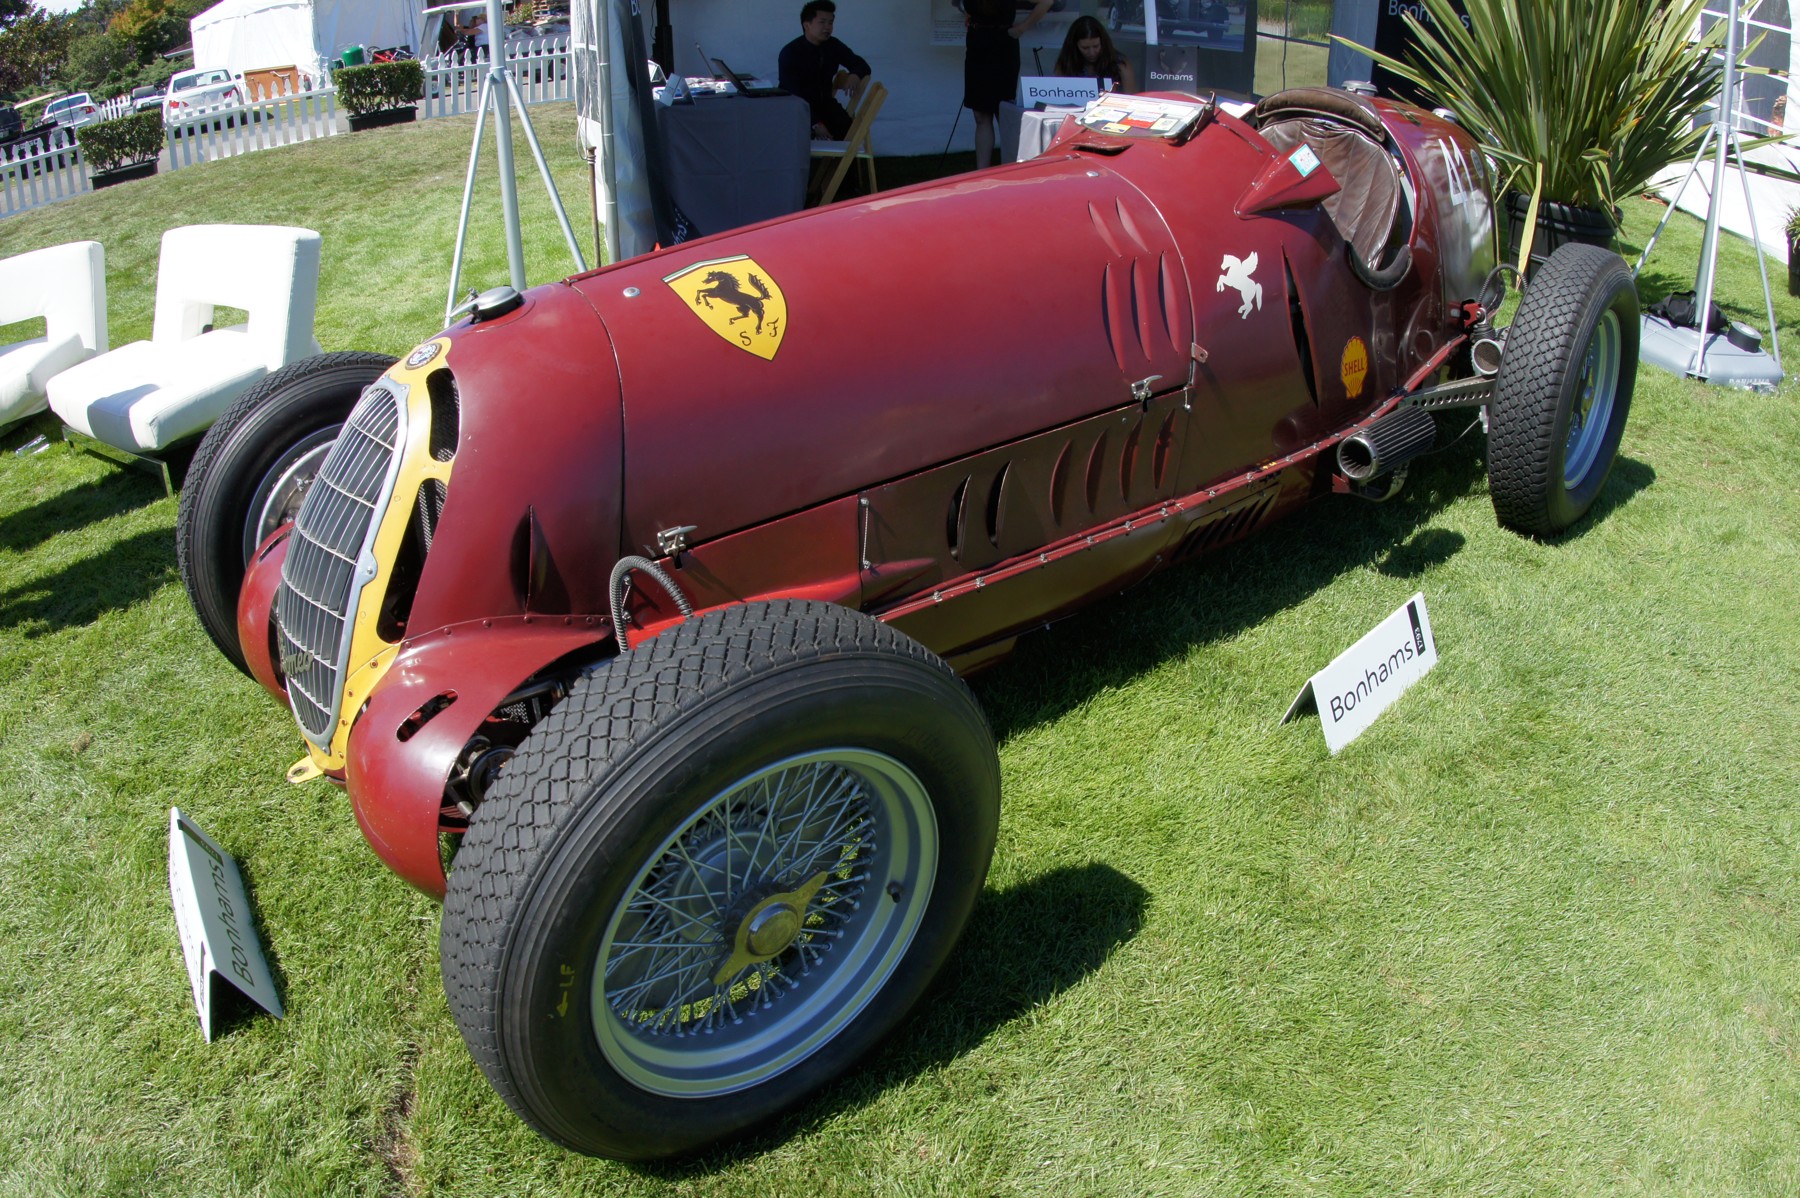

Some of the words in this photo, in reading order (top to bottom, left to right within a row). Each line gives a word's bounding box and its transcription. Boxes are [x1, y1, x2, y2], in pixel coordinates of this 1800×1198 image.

[1029, 86, 1096, 99] Bonhams
[739, 330, 752, 346] S
[1344, 358, 1364, 377] SHELL
[1329, 641, 1414, 723] Bonhams
[208, 858, 255, 988] Bonhams
[559, 963, 575, 987] LF
